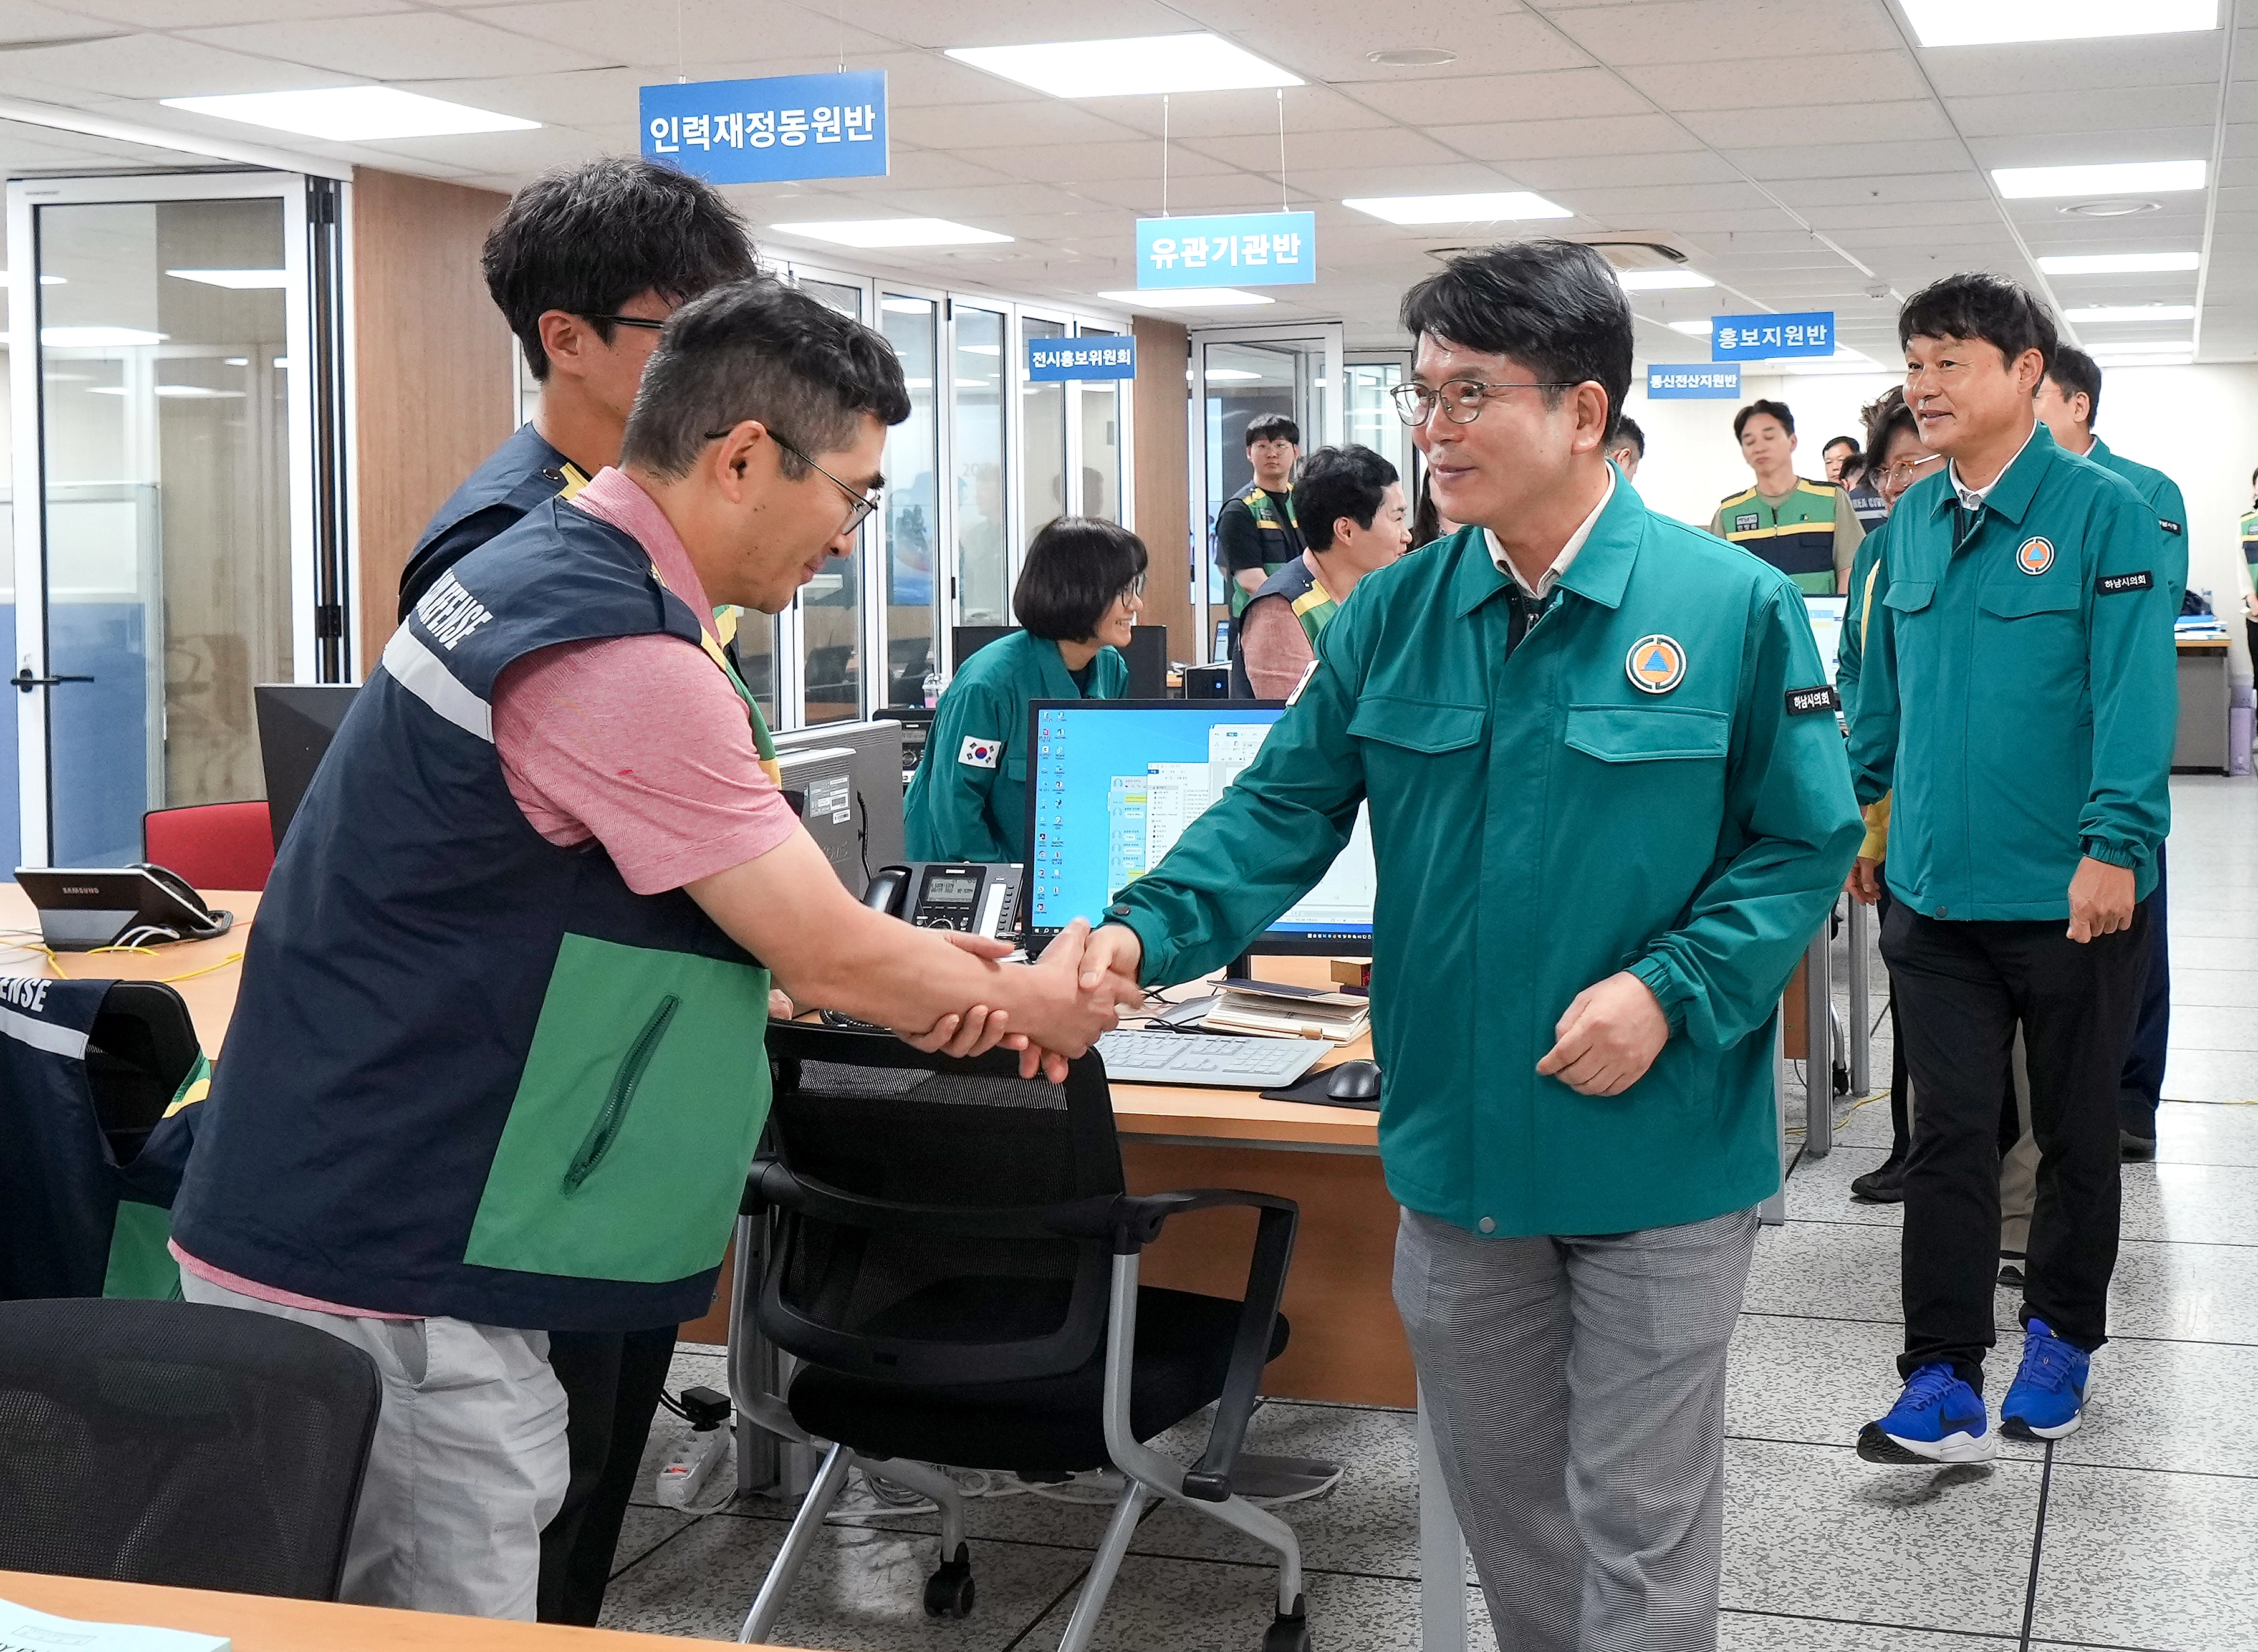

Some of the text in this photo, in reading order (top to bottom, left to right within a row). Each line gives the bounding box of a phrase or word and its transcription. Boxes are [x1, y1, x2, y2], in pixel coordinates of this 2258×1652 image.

[650, 104, 876, 154] 인력재정동원반
[1150, 233, 1302, 269] 유관기관반
[1718, 324, 1827, 349] 홍보지원반
[1032, 349, 1132, 368] 전시홍보위원회
[1650, 374, 1737, 388] 통신전산지원반
[2104, 574, 2146, 589] 하남시의회
[1794, 691, 1830, 709] 하남시의회
